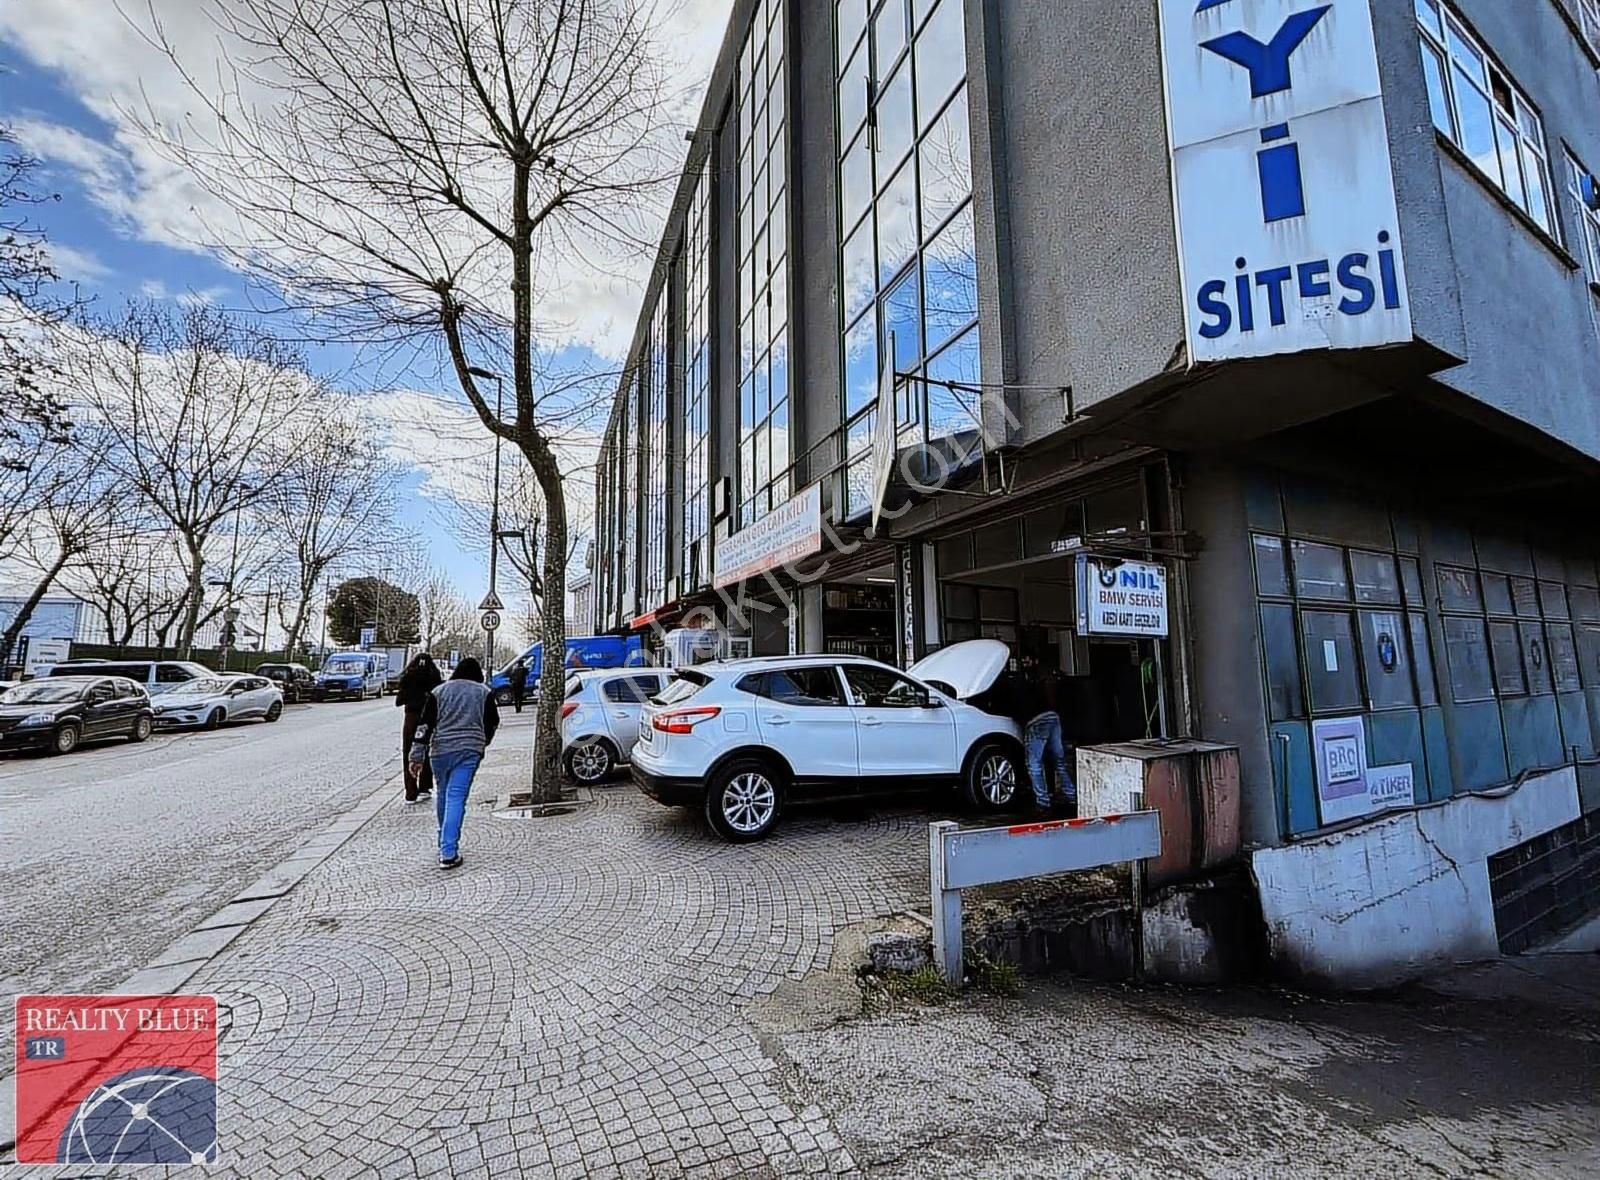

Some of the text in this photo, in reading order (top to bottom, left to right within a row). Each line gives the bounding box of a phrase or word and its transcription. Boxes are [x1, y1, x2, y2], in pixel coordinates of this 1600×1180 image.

[1119, 566, 1160, 590] NİL
[1099, 590, 1163, 608] BMW SERVİSİ
